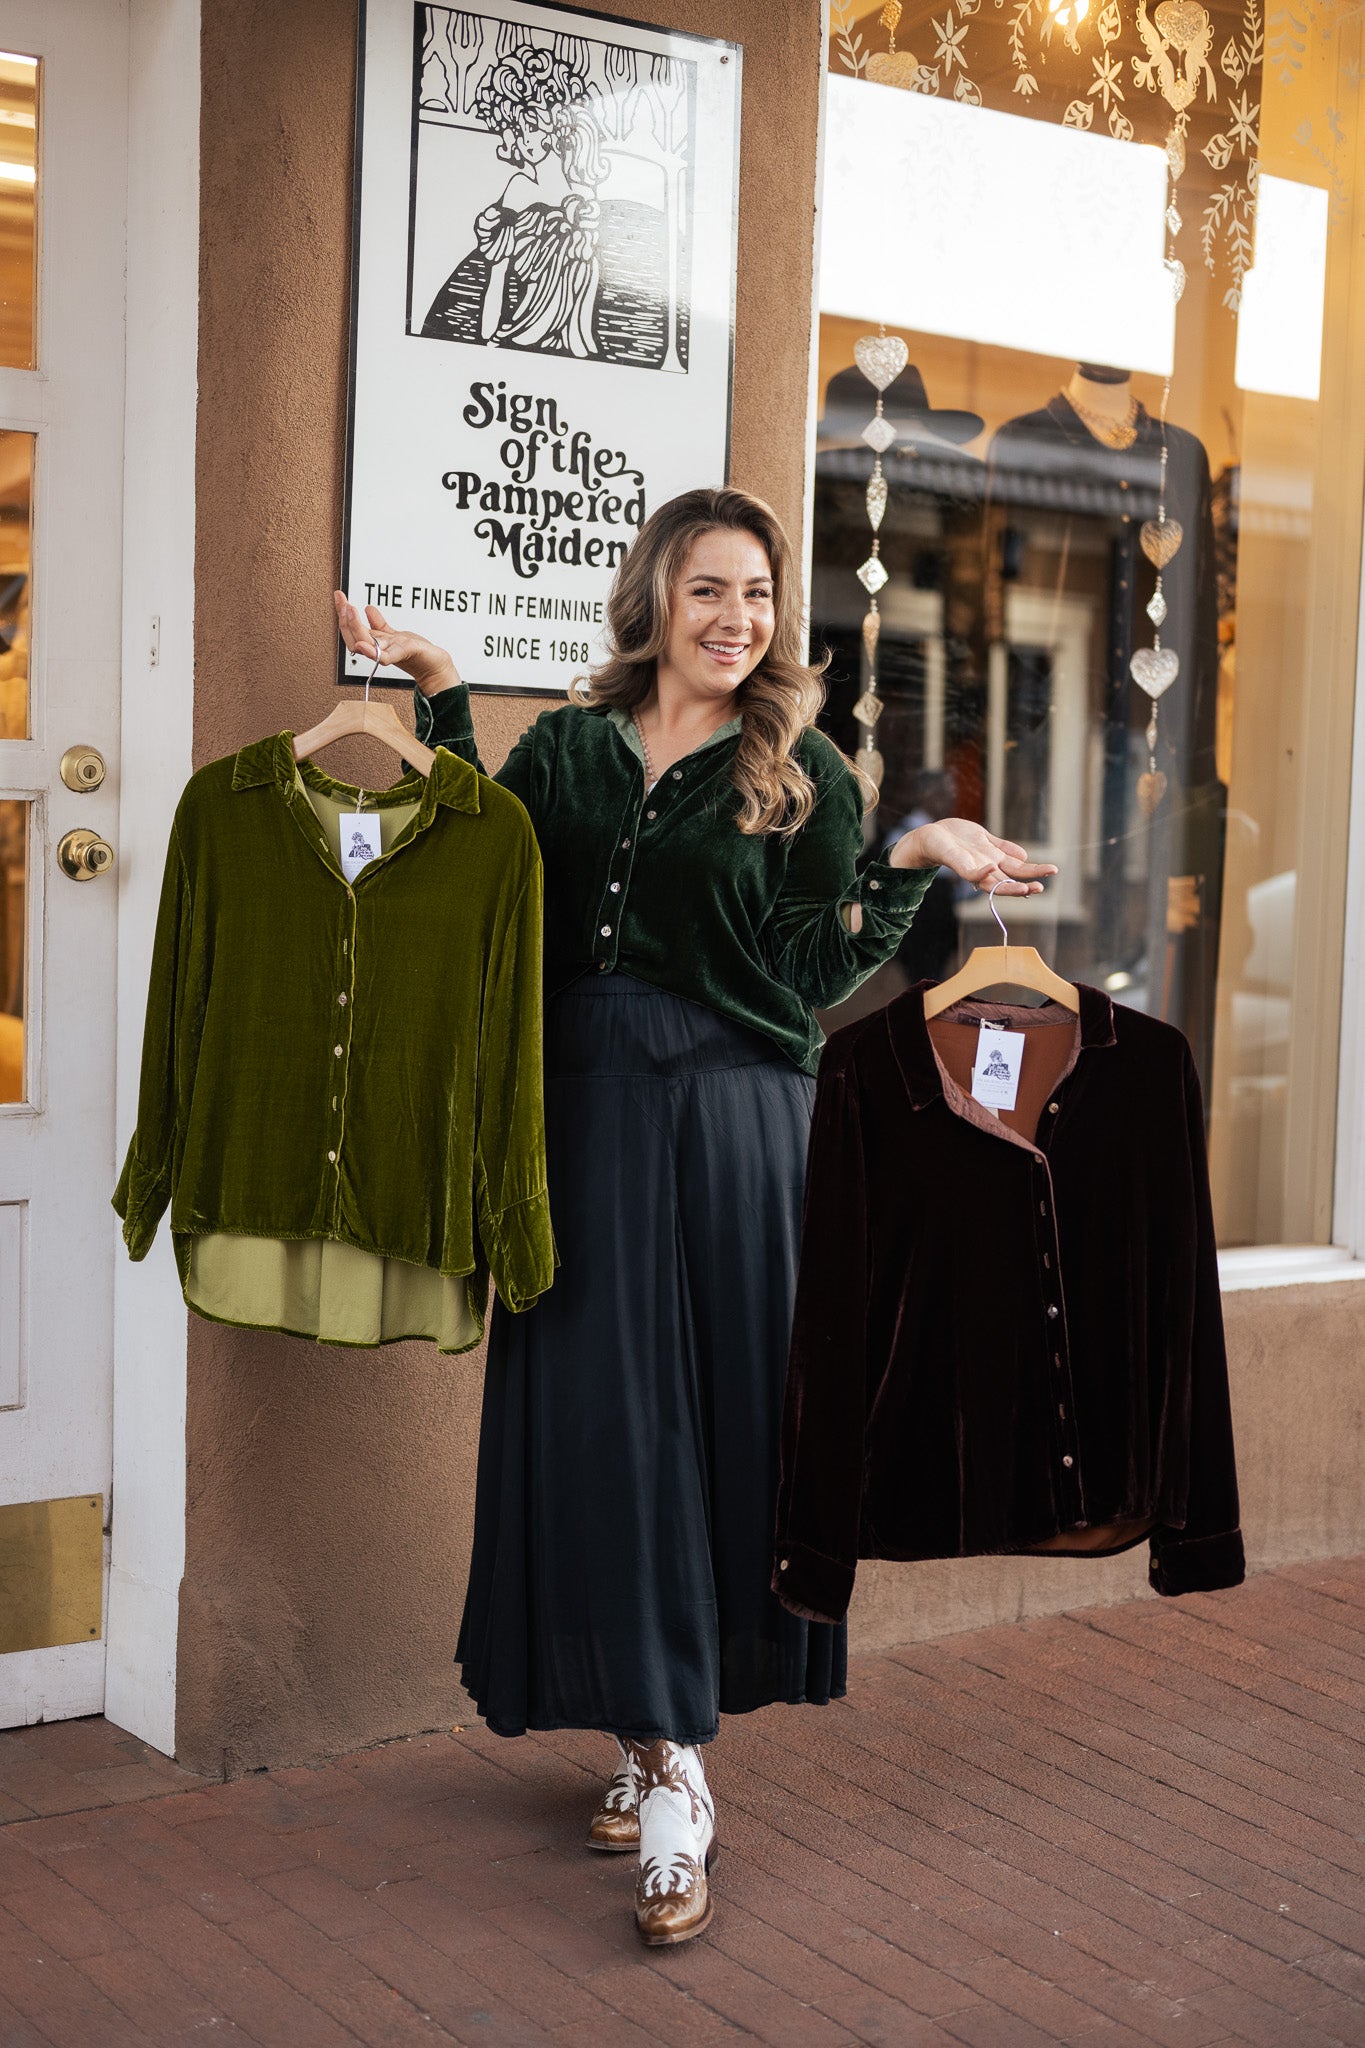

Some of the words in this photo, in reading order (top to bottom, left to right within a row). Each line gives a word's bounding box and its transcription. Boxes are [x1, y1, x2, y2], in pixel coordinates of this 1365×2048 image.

[463, 381, 568, 436] Sign
[500, 430, 549, 483] of
[551, 431, 644, 490] the
[441, 471, 646, 532] Pampered
[474, 518, 629, 578] Maiden
[364, 582, 403, 608] THE
[411, 586, 481, 613] FINEST
[489, 593, 506, 616] IN
[515, 595, 603, 623] FEMININE
[484, 635, 540, 660] SINCE
[550, 640, 589, 663] 1968
